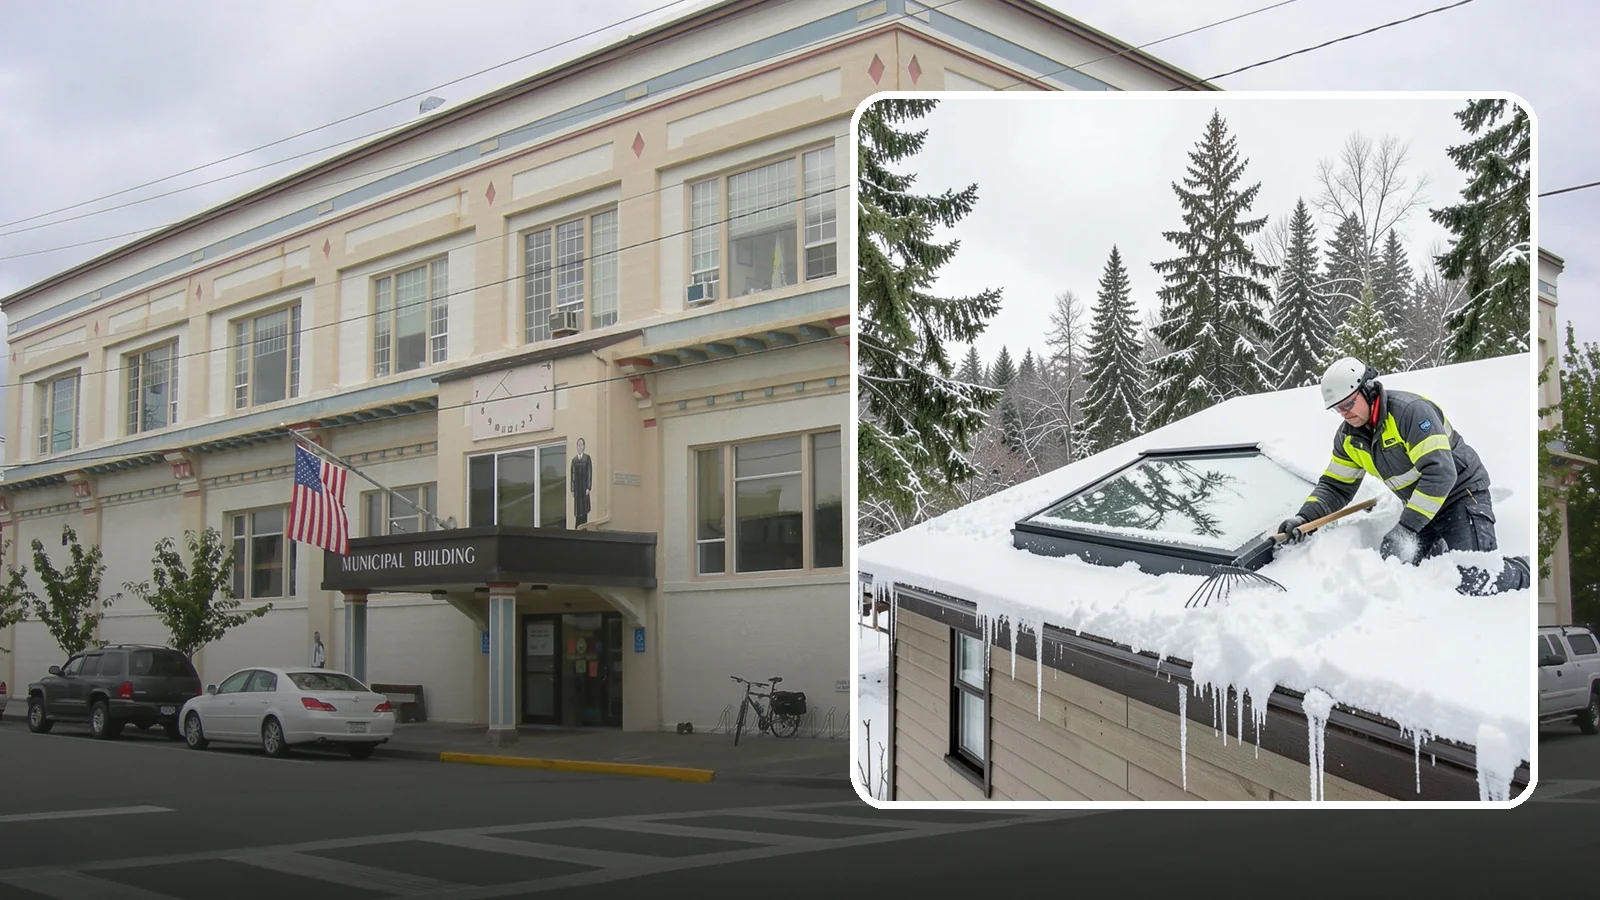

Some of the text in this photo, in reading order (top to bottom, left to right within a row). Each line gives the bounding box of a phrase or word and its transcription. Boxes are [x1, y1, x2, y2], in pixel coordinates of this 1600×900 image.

[546, 361, 551, 370] 6
[536, 402, 540, 410] 4
[481, 407, 485, 415] 8
[488, 417, 492, 425] 9
[521, 420, 525, 428] 2
[495, 424, 500, 432] 10
[507, 425, 513, 433] 12
[342, 546, 475, 572] MUNICIPAL BUILDING
